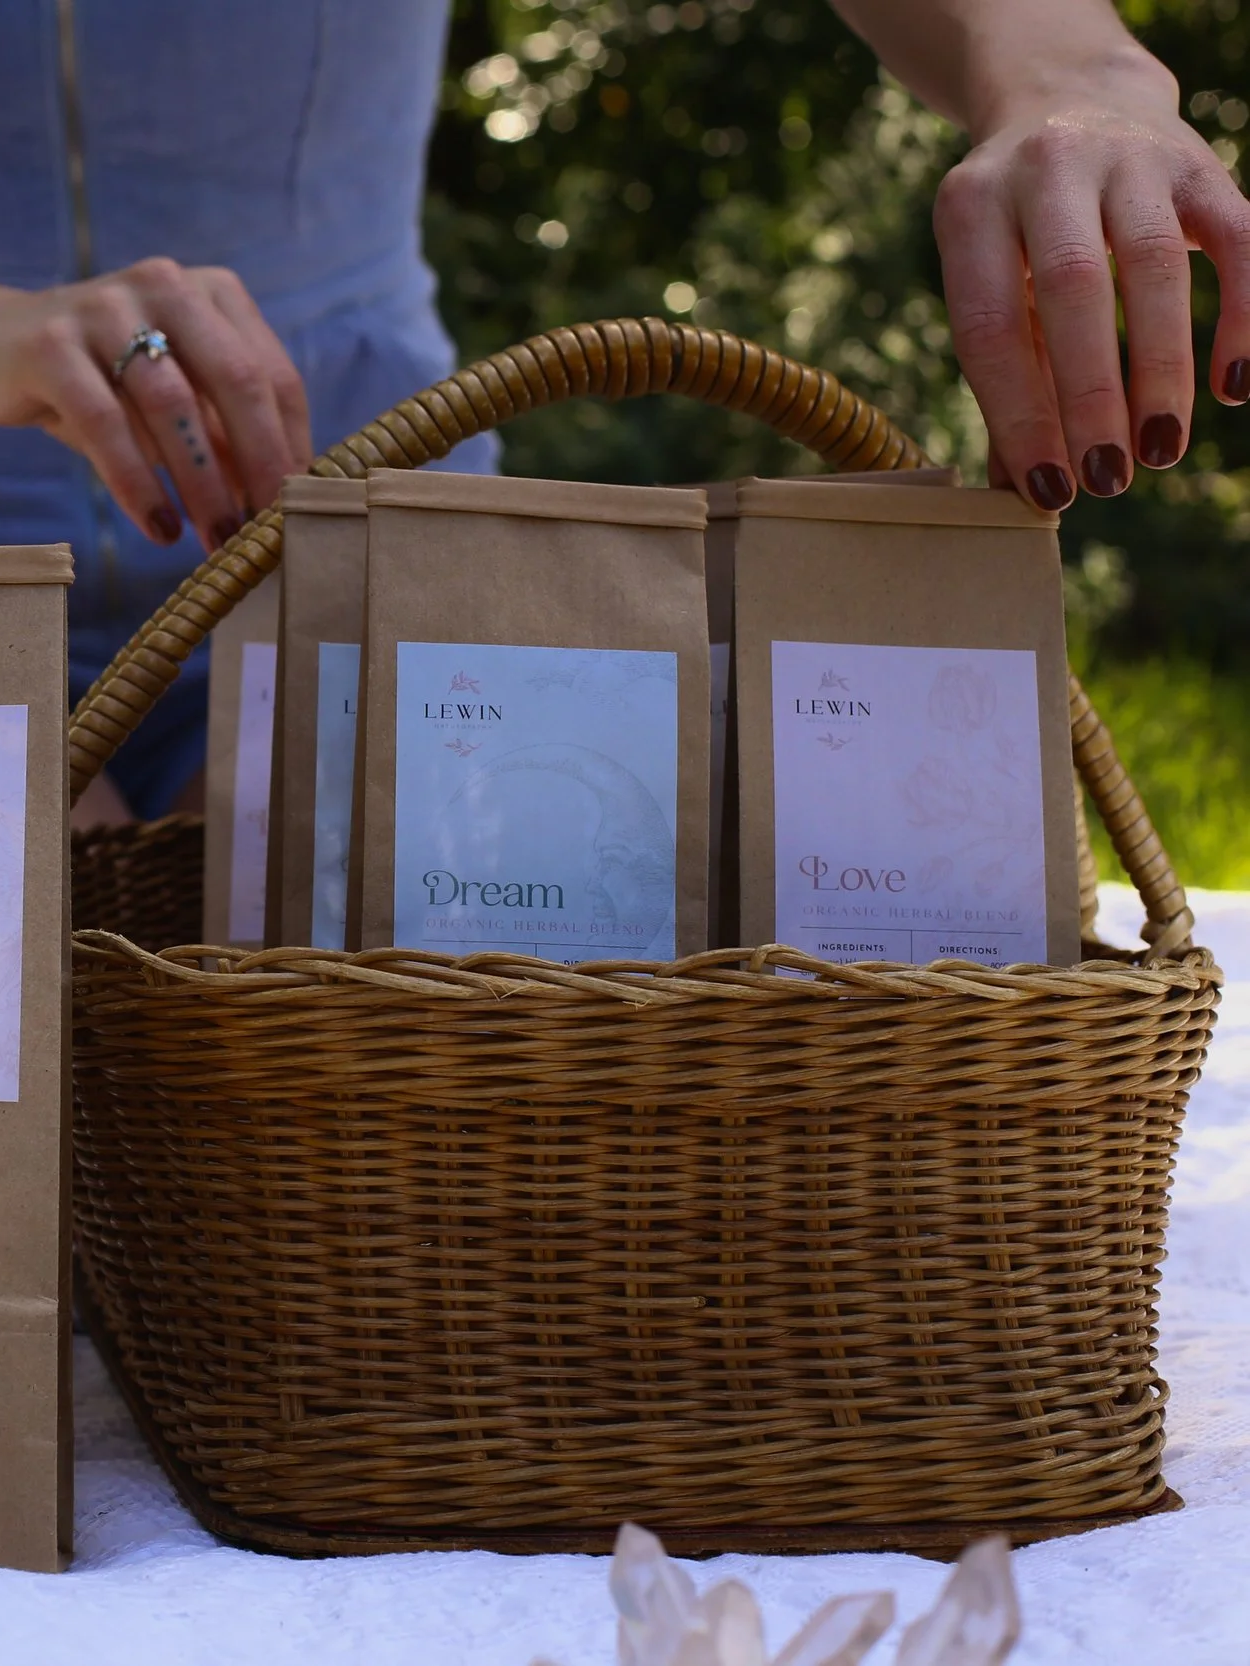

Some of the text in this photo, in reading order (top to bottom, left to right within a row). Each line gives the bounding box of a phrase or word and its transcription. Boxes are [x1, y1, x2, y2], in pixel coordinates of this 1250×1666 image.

[424, 703, 502, 720] LEWIN
[795, 699, 871, 716] LEWIN
[799, 855, 906, 893] Love
[422, 869, 565, 909] Dream
[803, 905, 1019, 921] ORGANIC HERBAL BLEND
[426, 918, 645, 935] ORGANIC HERBAL BLEND
